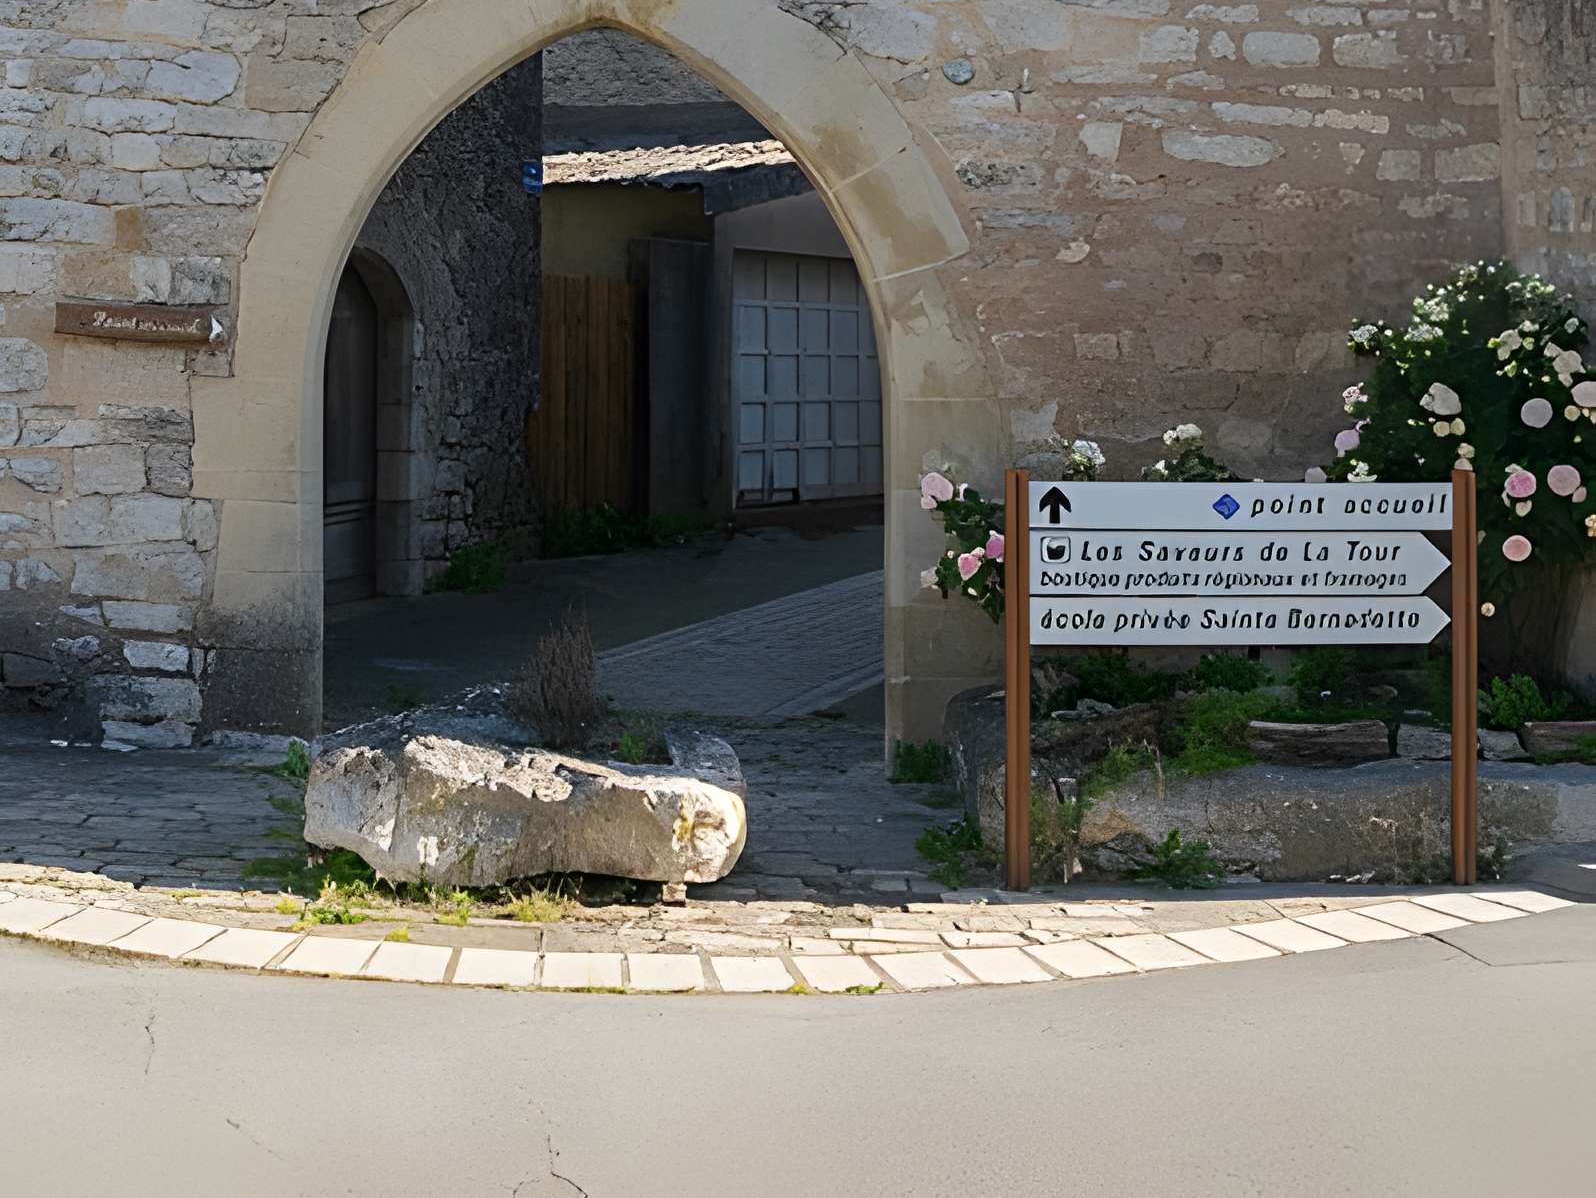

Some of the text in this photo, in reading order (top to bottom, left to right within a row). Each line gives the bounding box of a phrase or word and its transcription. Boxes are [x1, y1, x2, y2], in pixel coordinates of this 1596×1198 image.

[1250, 493, 1325, 518] point
[1303, 540, 1329, 562] La
[1346, 539, 1401, 562] Tour
